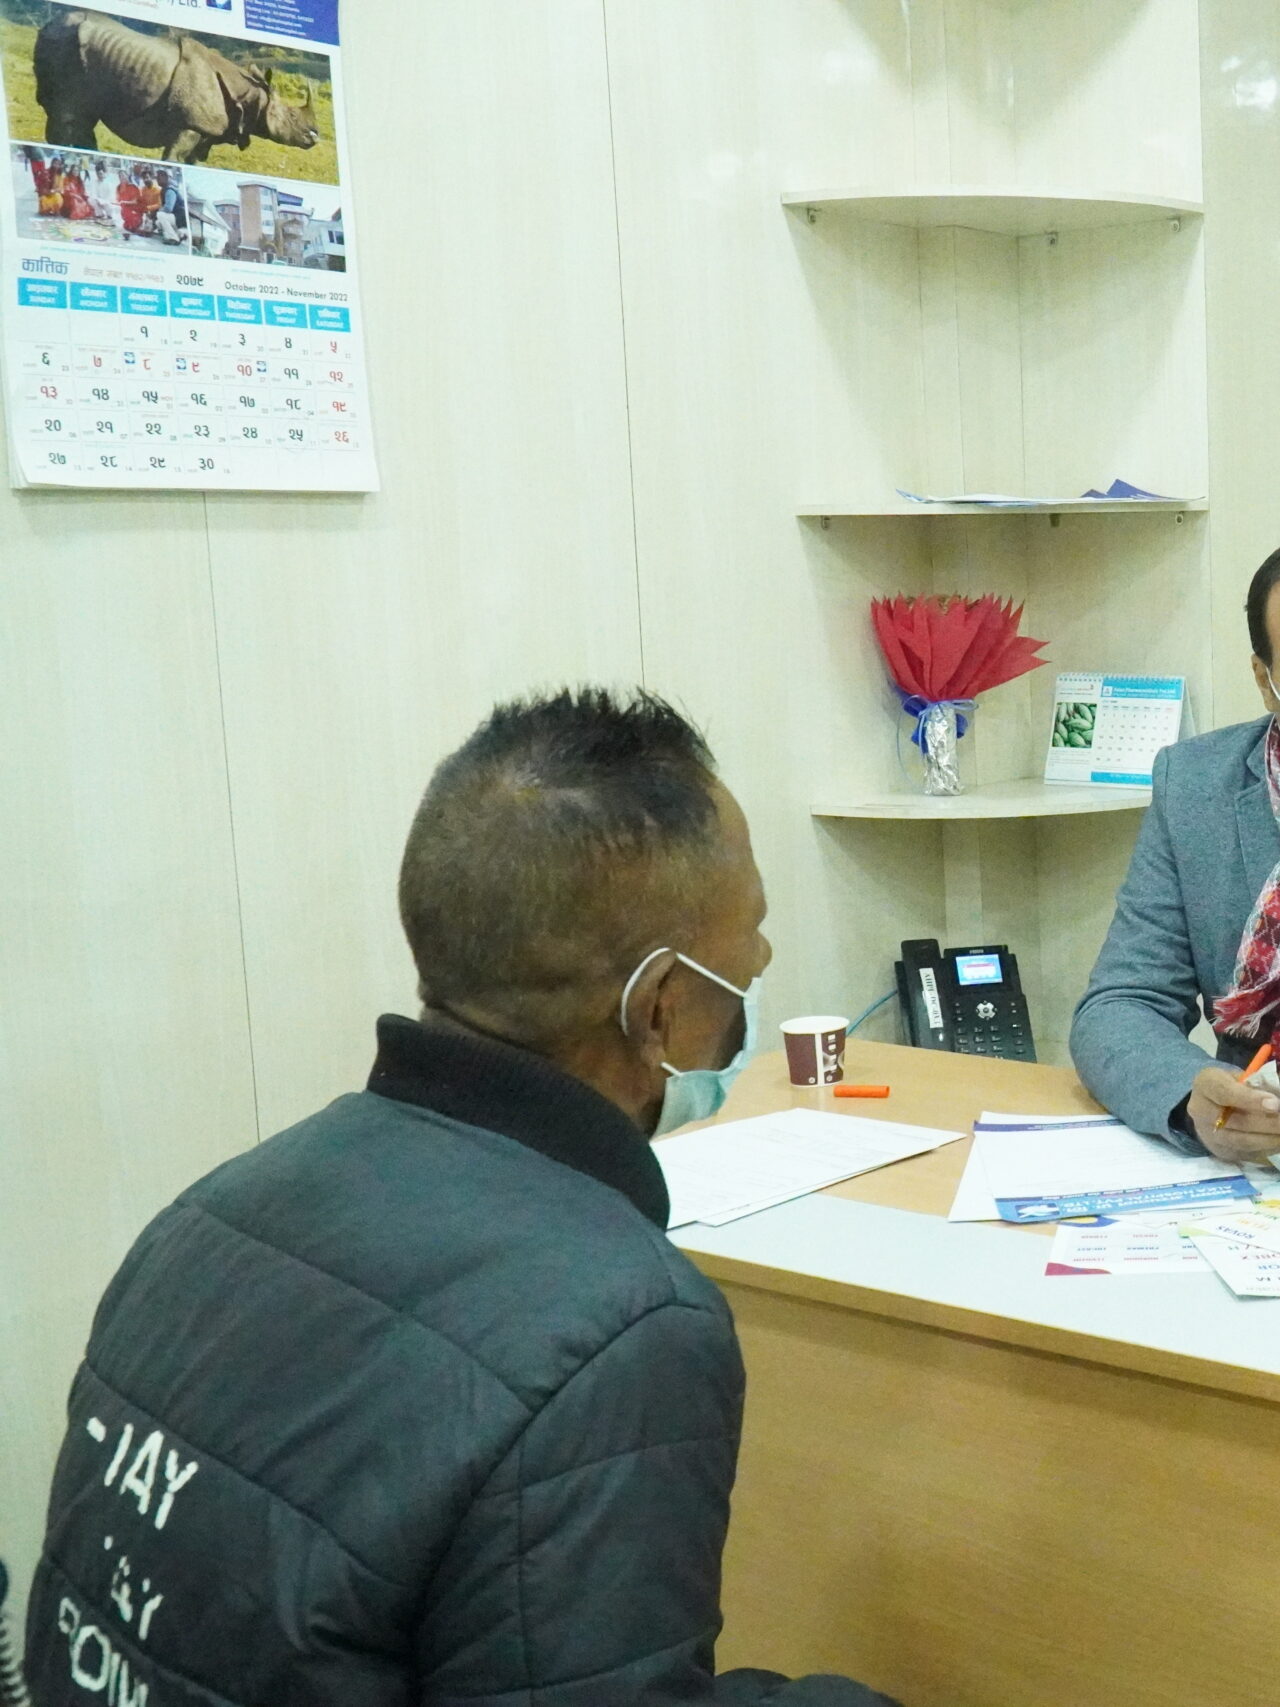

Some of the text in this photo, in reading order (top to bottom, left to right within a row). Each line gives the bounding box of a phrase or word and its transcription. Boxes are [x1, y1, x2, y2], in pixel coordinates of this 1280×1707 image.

[224, 281, 256, 293] October
[258, 284, 279, 295] 2022
[286, 287, 327, 299] November
[329, 292, 348, 301] 2022
